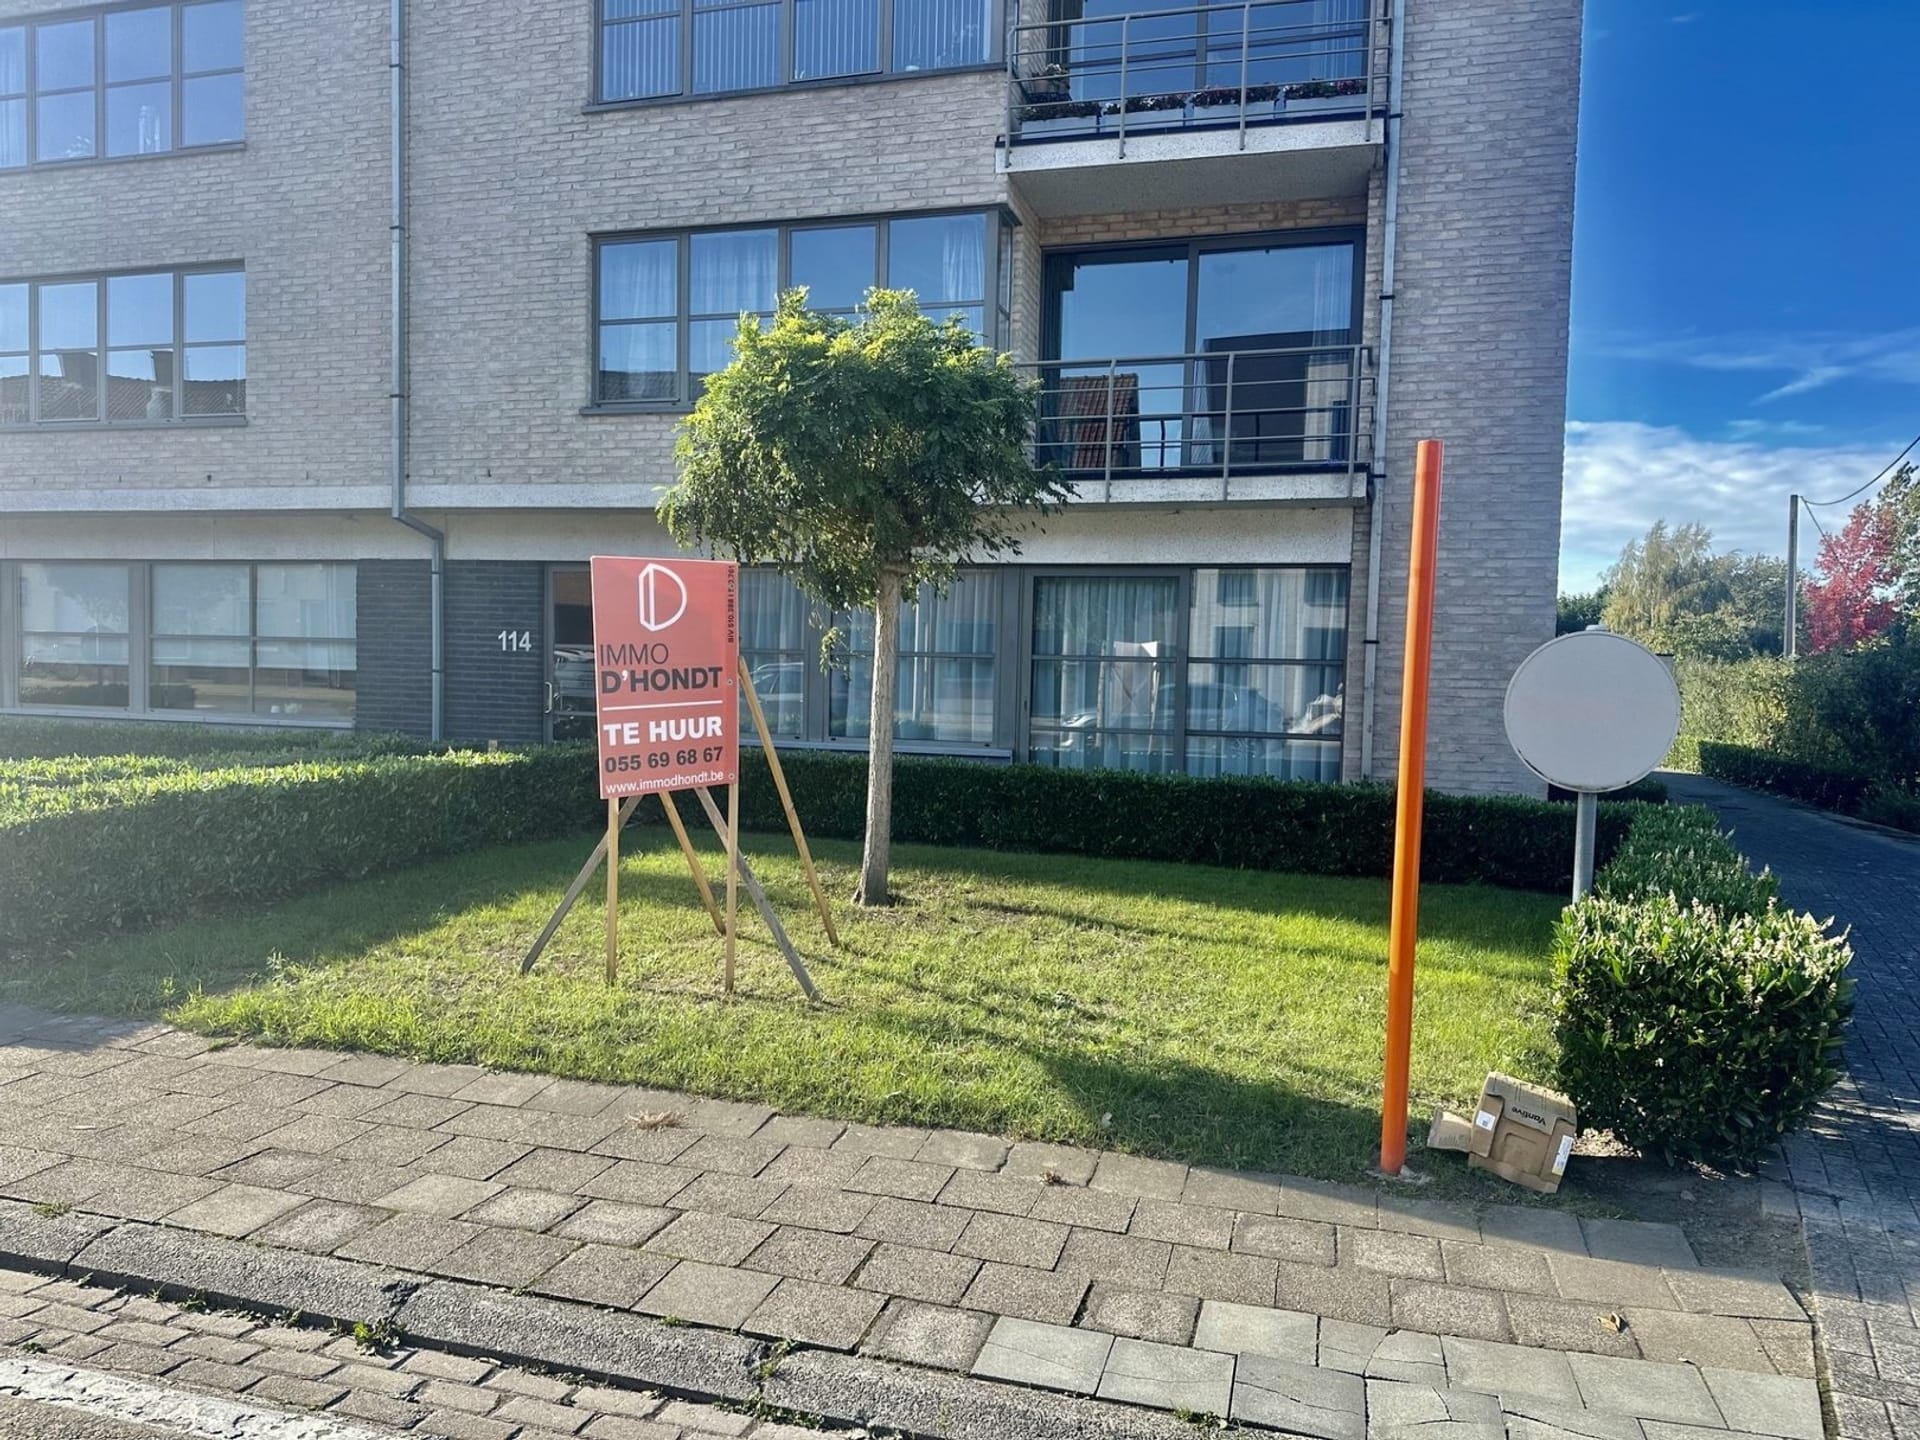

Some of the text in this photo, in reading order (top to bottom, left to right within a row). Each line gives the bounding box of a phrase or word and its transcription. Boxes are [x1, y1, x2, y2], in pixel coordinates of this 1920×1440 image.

[497, 630, 532, 652] 114
[727, 629, 735, 643] BIV
[600, 643, 669, 666] IMMO
[603, 716, 723, 746] TE HUUR
[605, 746, 723, 773] 055 69 68 67
[605, 770, 724, 794] www.immodhondt.be
[1511, 1106, 1547, 1128] Vantive
